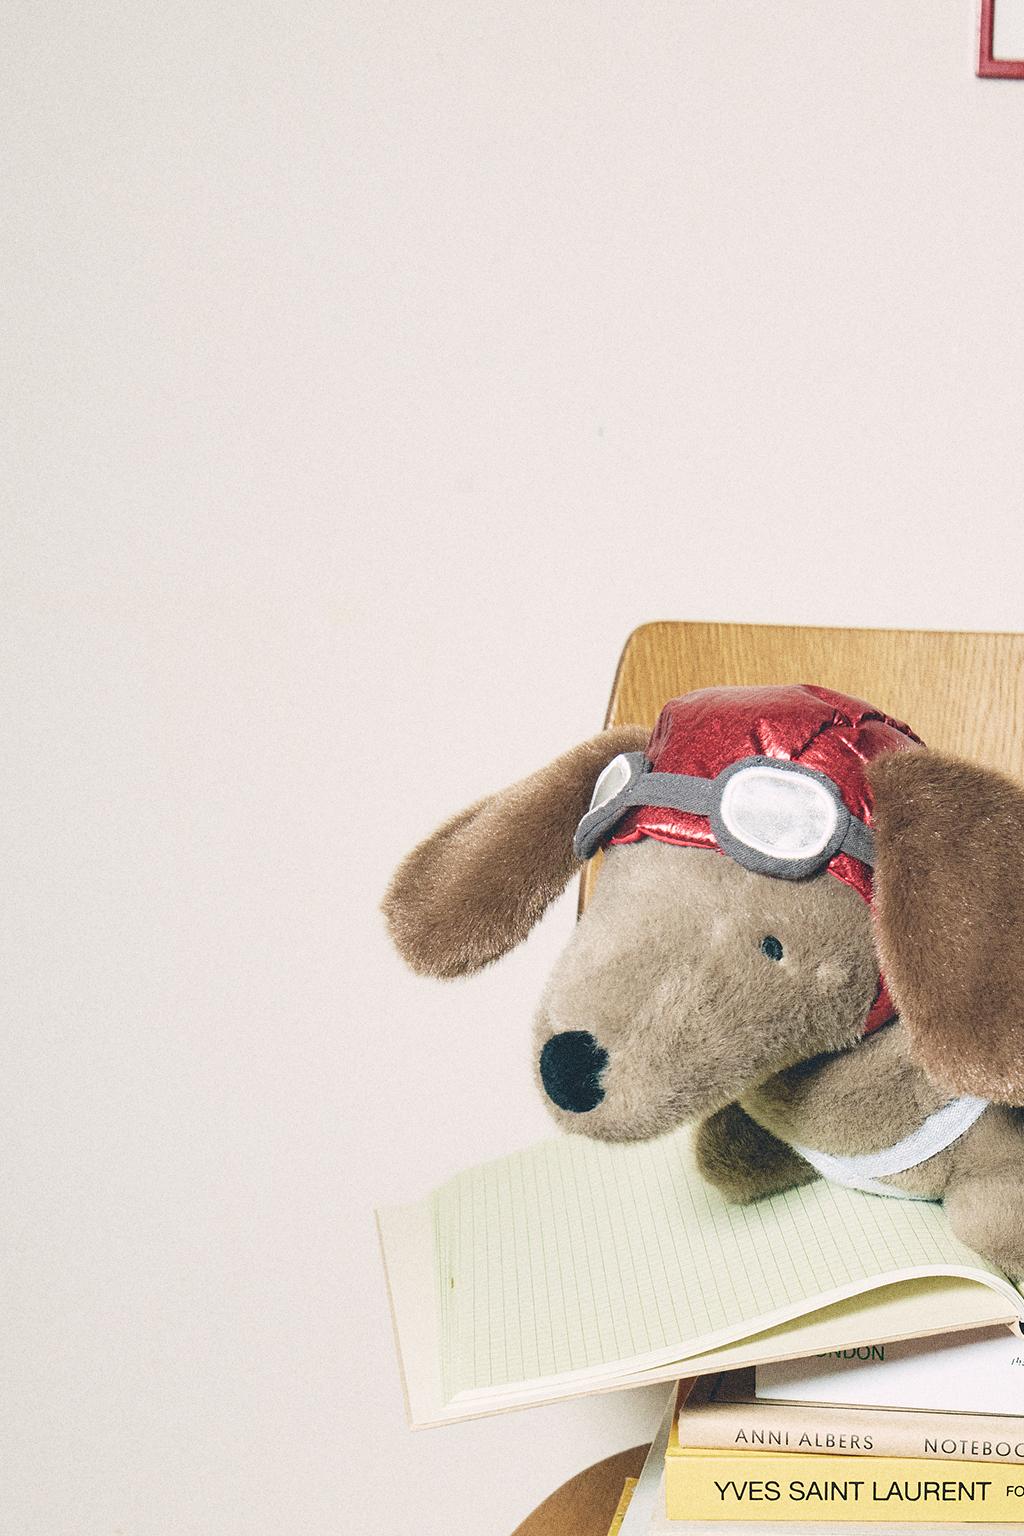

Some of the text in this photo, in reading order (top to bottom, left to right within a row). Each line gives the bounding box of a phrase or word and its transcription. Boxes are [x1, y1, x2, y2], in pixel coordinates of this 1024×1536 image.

[735, 1428, 875, 1451] ANNI ALBERS
[713, 1480, 993, 1502] YVES SAINT LAURENT
